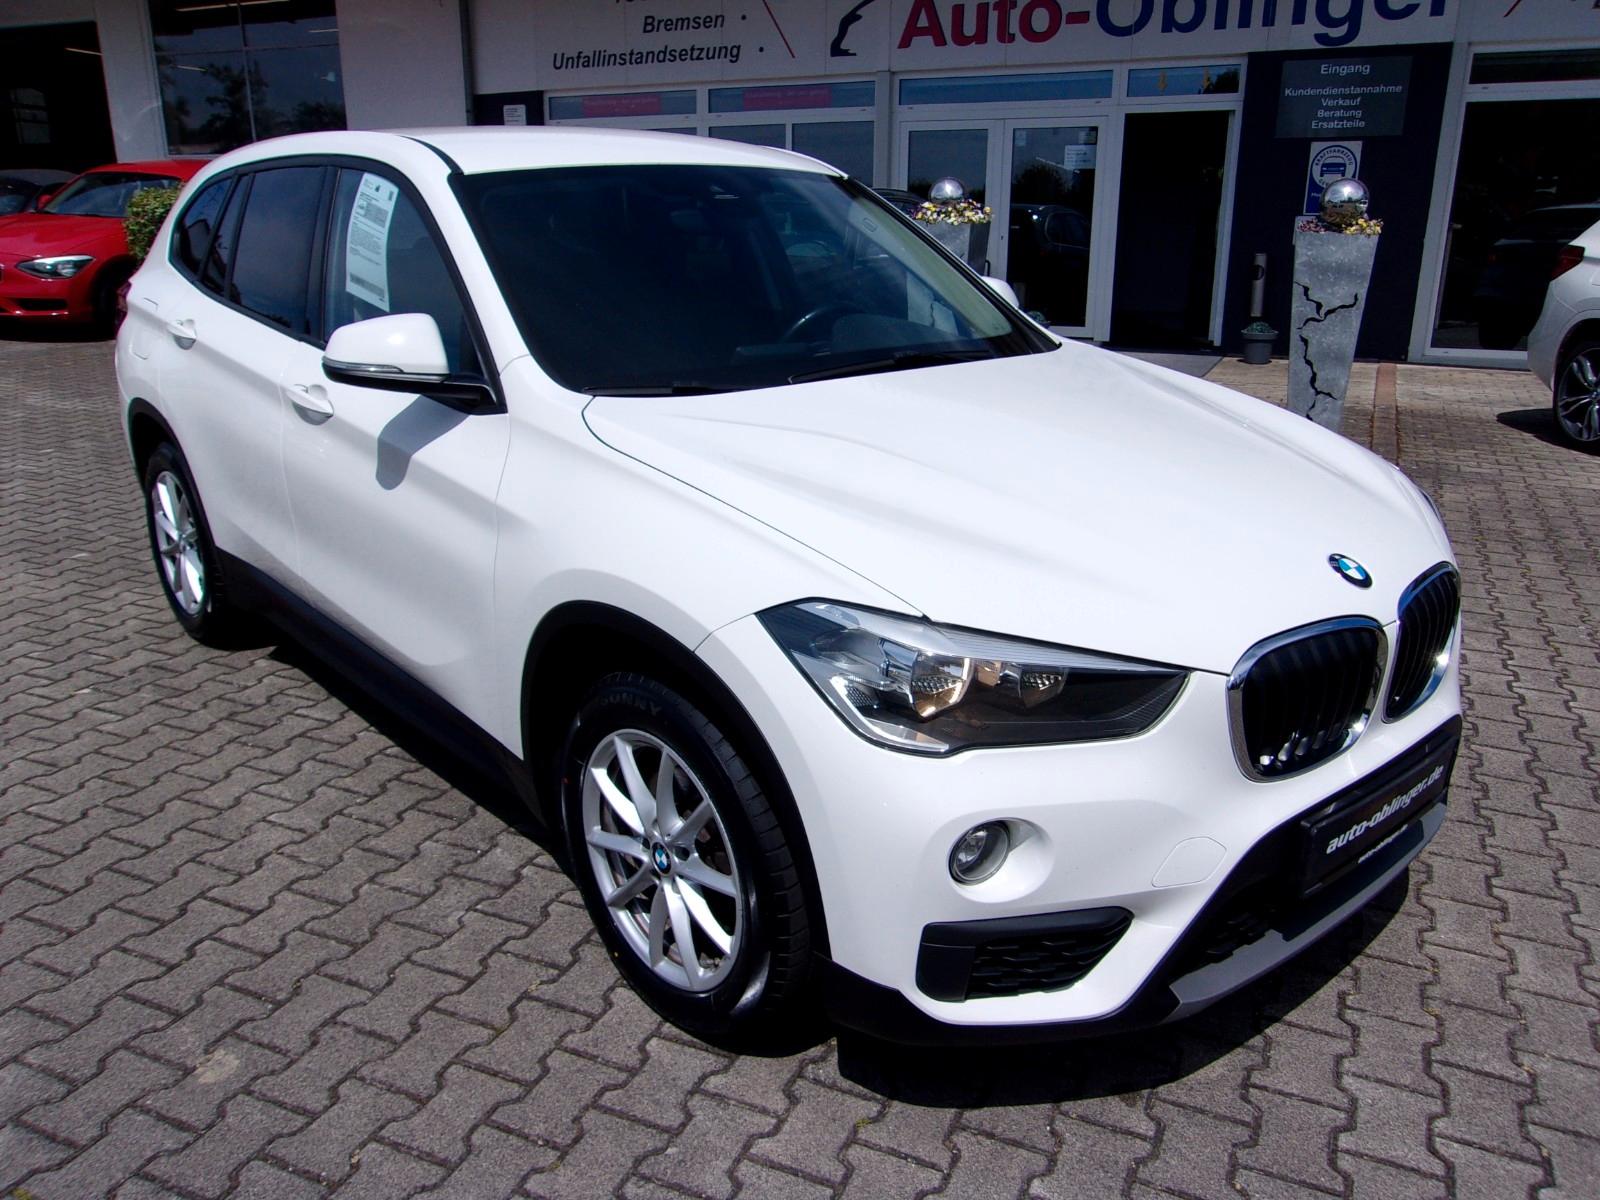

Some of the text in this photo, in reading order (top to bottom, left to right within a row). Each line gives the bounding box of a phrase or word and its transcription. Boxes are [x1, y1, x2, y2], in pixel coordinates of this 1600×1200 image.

[642, 14, 725, 33] Bremsen
[552, 44, 742, 70] Unfallinstandsetzung
[1320, 64, 1371, 76] Eingang
[1284, 84, 1403, 97] Kundendienstannahme
[1321, 97, 1362, 107] Verkauf
[1317, 109, 1363, 119] Beratung
[1311, 119, 1366, 129] Ersatzteile
[1326, 765, 1444, 855] auto-oblinger.de
